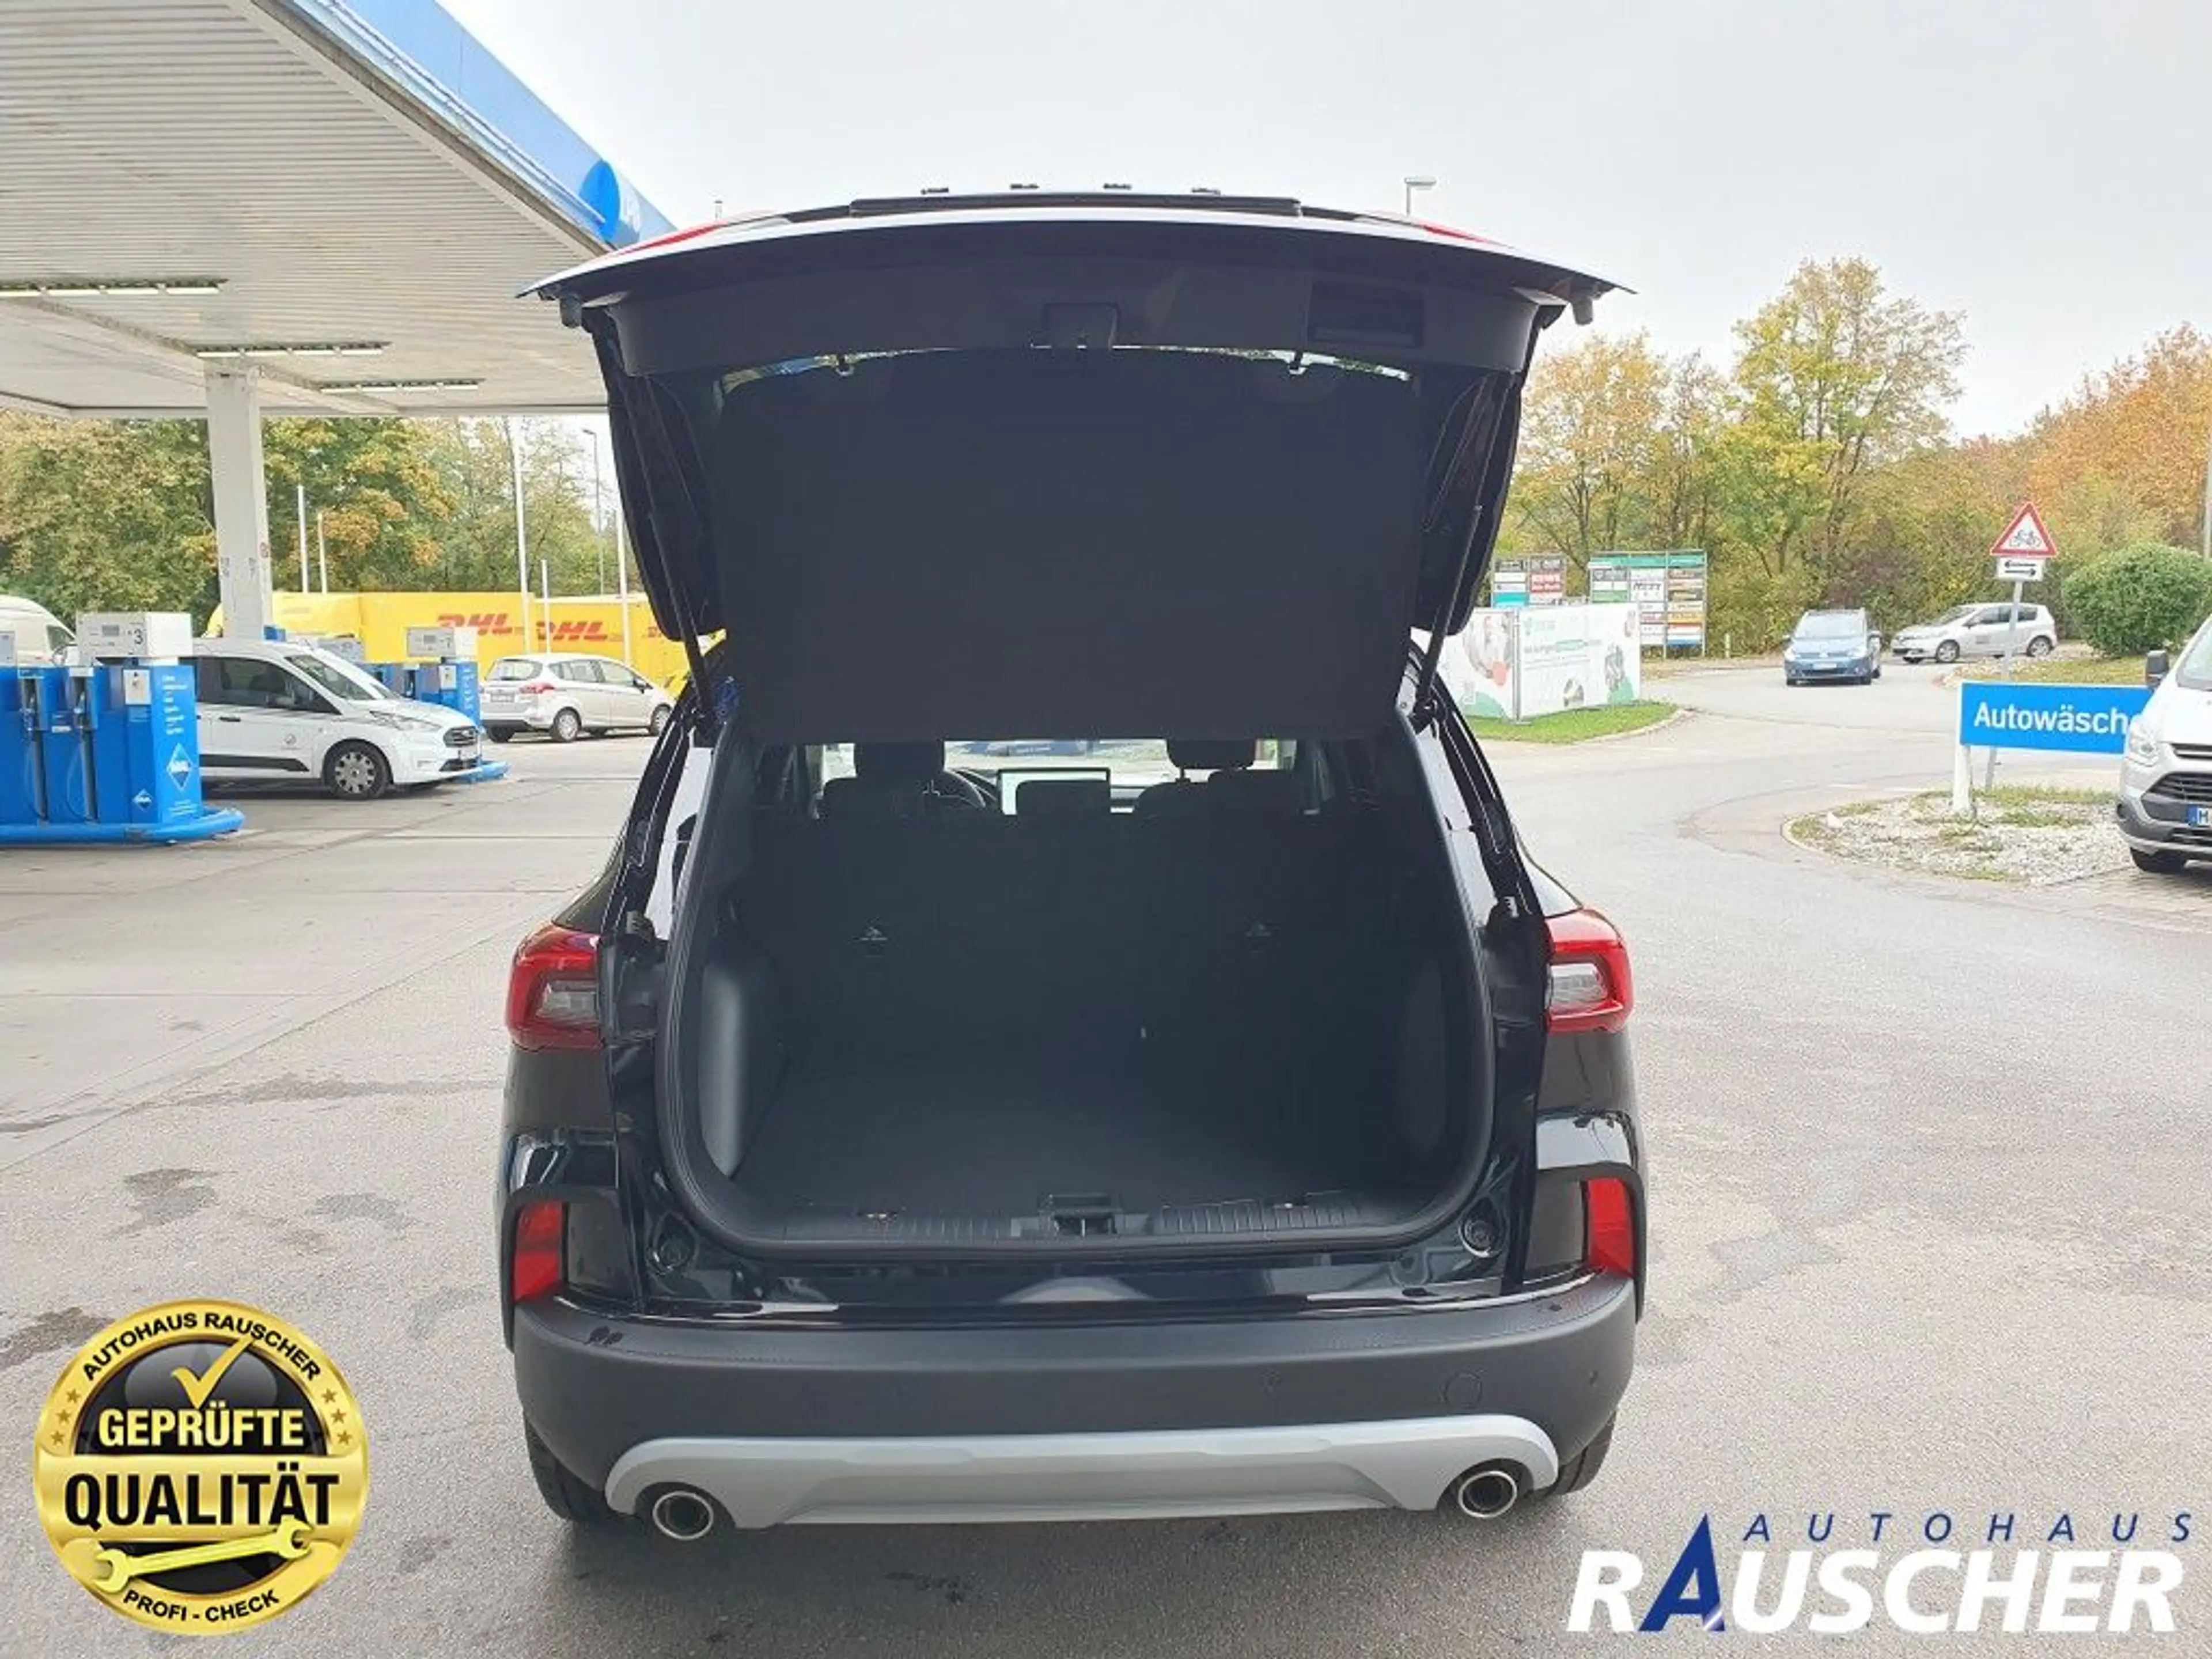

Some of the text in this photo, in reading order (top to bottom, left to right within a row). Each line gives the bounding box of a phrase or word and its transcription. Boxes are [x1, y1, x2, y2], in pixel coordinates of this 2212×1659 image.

[437, 613, 513, 635] DHL
[536, 622, 608, 642] DHL
[1974, 702, 2138, 735] Autowäsch
